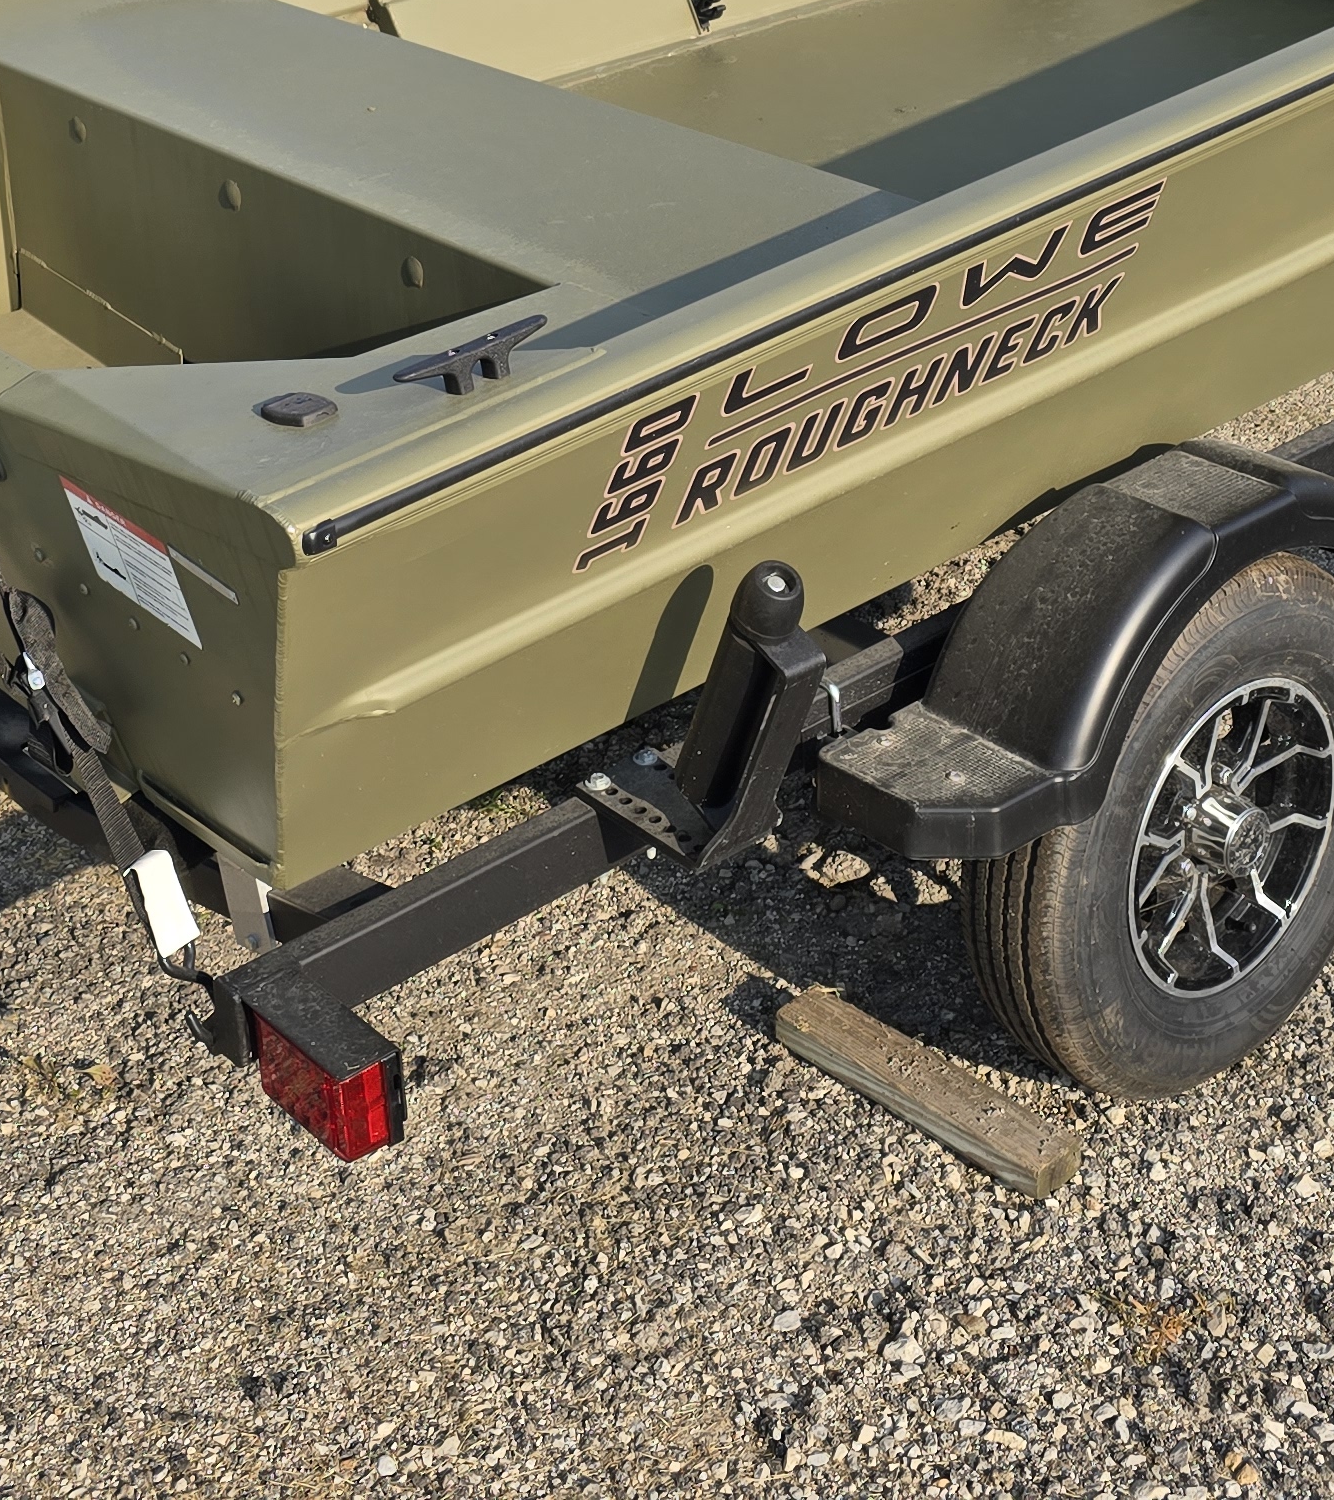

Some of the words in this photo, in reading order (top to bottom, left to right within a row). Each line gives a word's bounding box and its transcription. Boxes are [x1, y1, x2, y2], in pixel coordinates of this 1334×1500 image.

[672, 271, 1125, 530] ROUGHNECK
[721, 177, 1168, 417] LOWE
[572, 391, 702, 574] 1660
